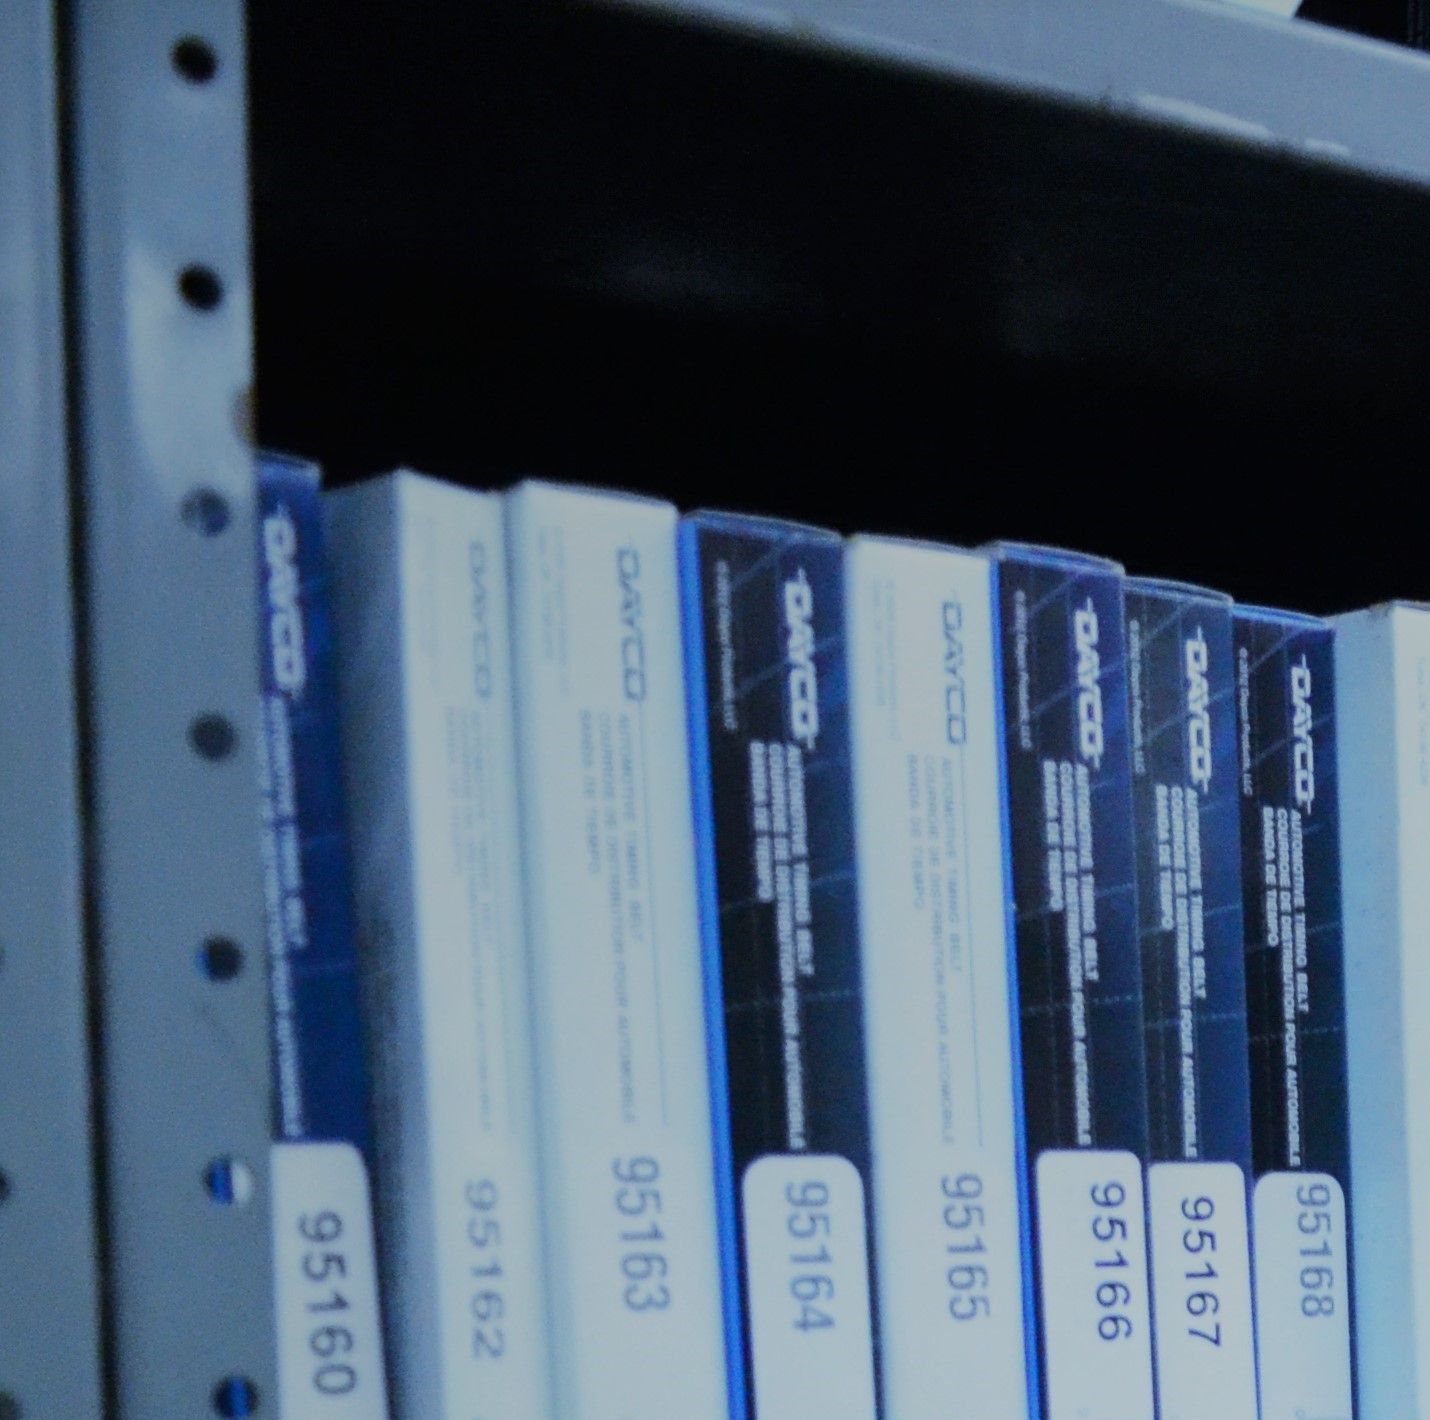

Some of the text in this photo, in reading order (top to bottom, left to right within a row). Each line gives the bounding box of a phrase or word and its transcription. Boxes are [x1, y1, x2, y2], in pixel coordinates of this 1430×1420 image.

[262, 513, 306, 692] DAYCO
[615, 547, 649, 706] DAYCO
[783, 578, 819, 740] DAYCO
[941, 599, 969, 747] DAYCO
[1074, 609, 1105, 757] DAYCO
[1186, 639, 1213, 780] DAYCO
[1290, 665, 1315, 801] DAYCO
[297, 1210, 360, 1397] 95160
[464, 1178, 505, 1361] 95162
[611, 1155, 672, 1314] 95163
[783, 1178, 836, 1334] 95164
[941, 1172, 992, 1322] 95165
[1089, 1180, 1134, 1342] 95166
[1181, 1194, 1223, 1348] 95167
[1295, 1182, 1336, 1318] 95168
